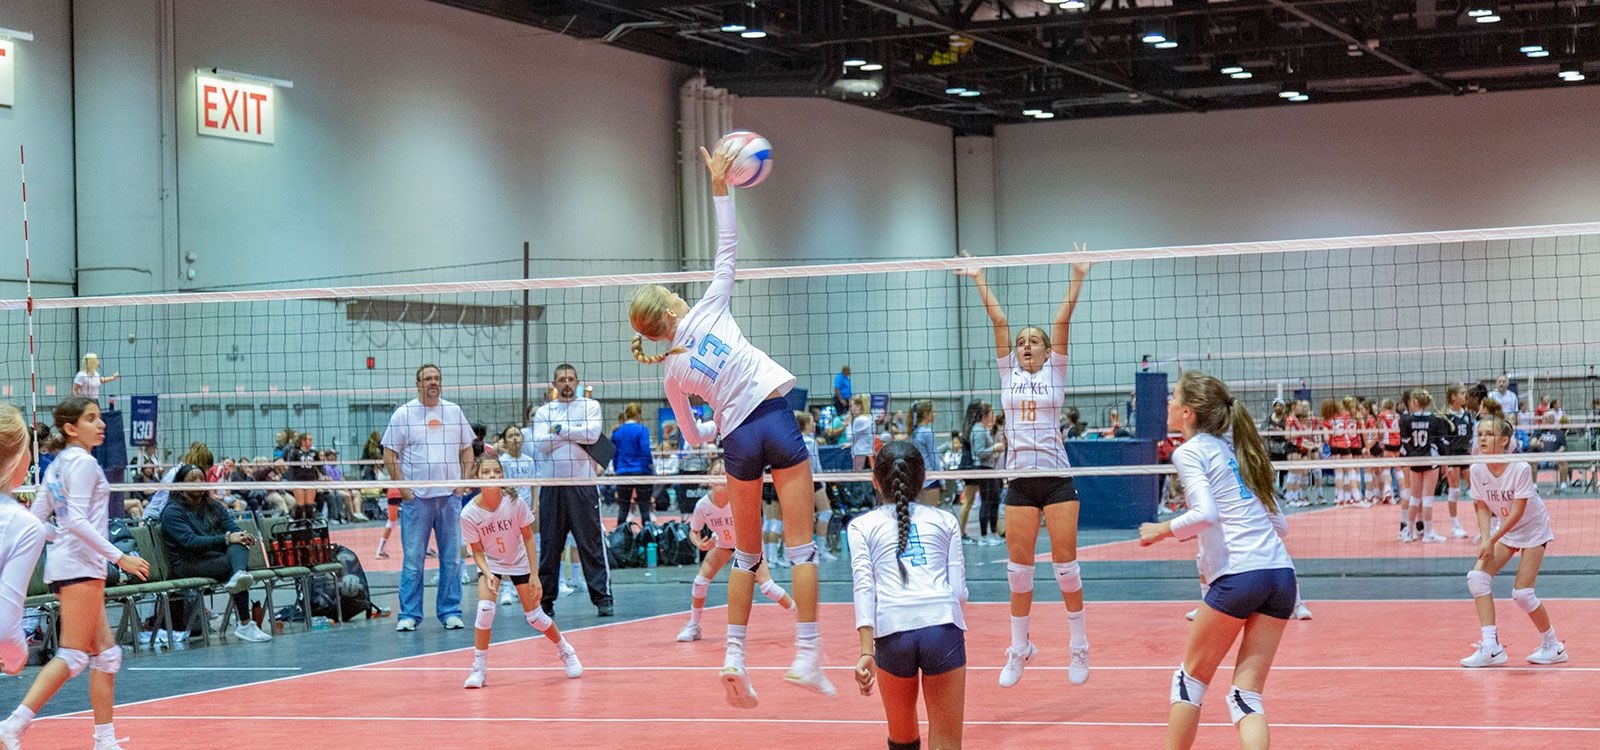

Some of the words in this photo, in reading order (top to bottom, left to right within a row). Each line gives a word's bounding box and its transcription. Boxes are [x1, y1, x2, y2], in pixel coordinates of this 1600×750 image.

[203, 84, 267, 135] EXIT
[690, 333, 732, 384] 13
[1021, 400, 1037, 421] 18
[132, 420, 154, 440] 130
[1412, 429, 1428, 447] 10
[1486, 489, 1500, 502] THE
[1500, 489, 1515, 502] KEY
[480, 521, 496, 537] THE
[496, 519, 513, 532] KEY
[710, 517, 724, 527] THE
[723, 529, 732, 541] 8
[495, 536, 506, 554] 5
[895, 523, 928, 567] 4
